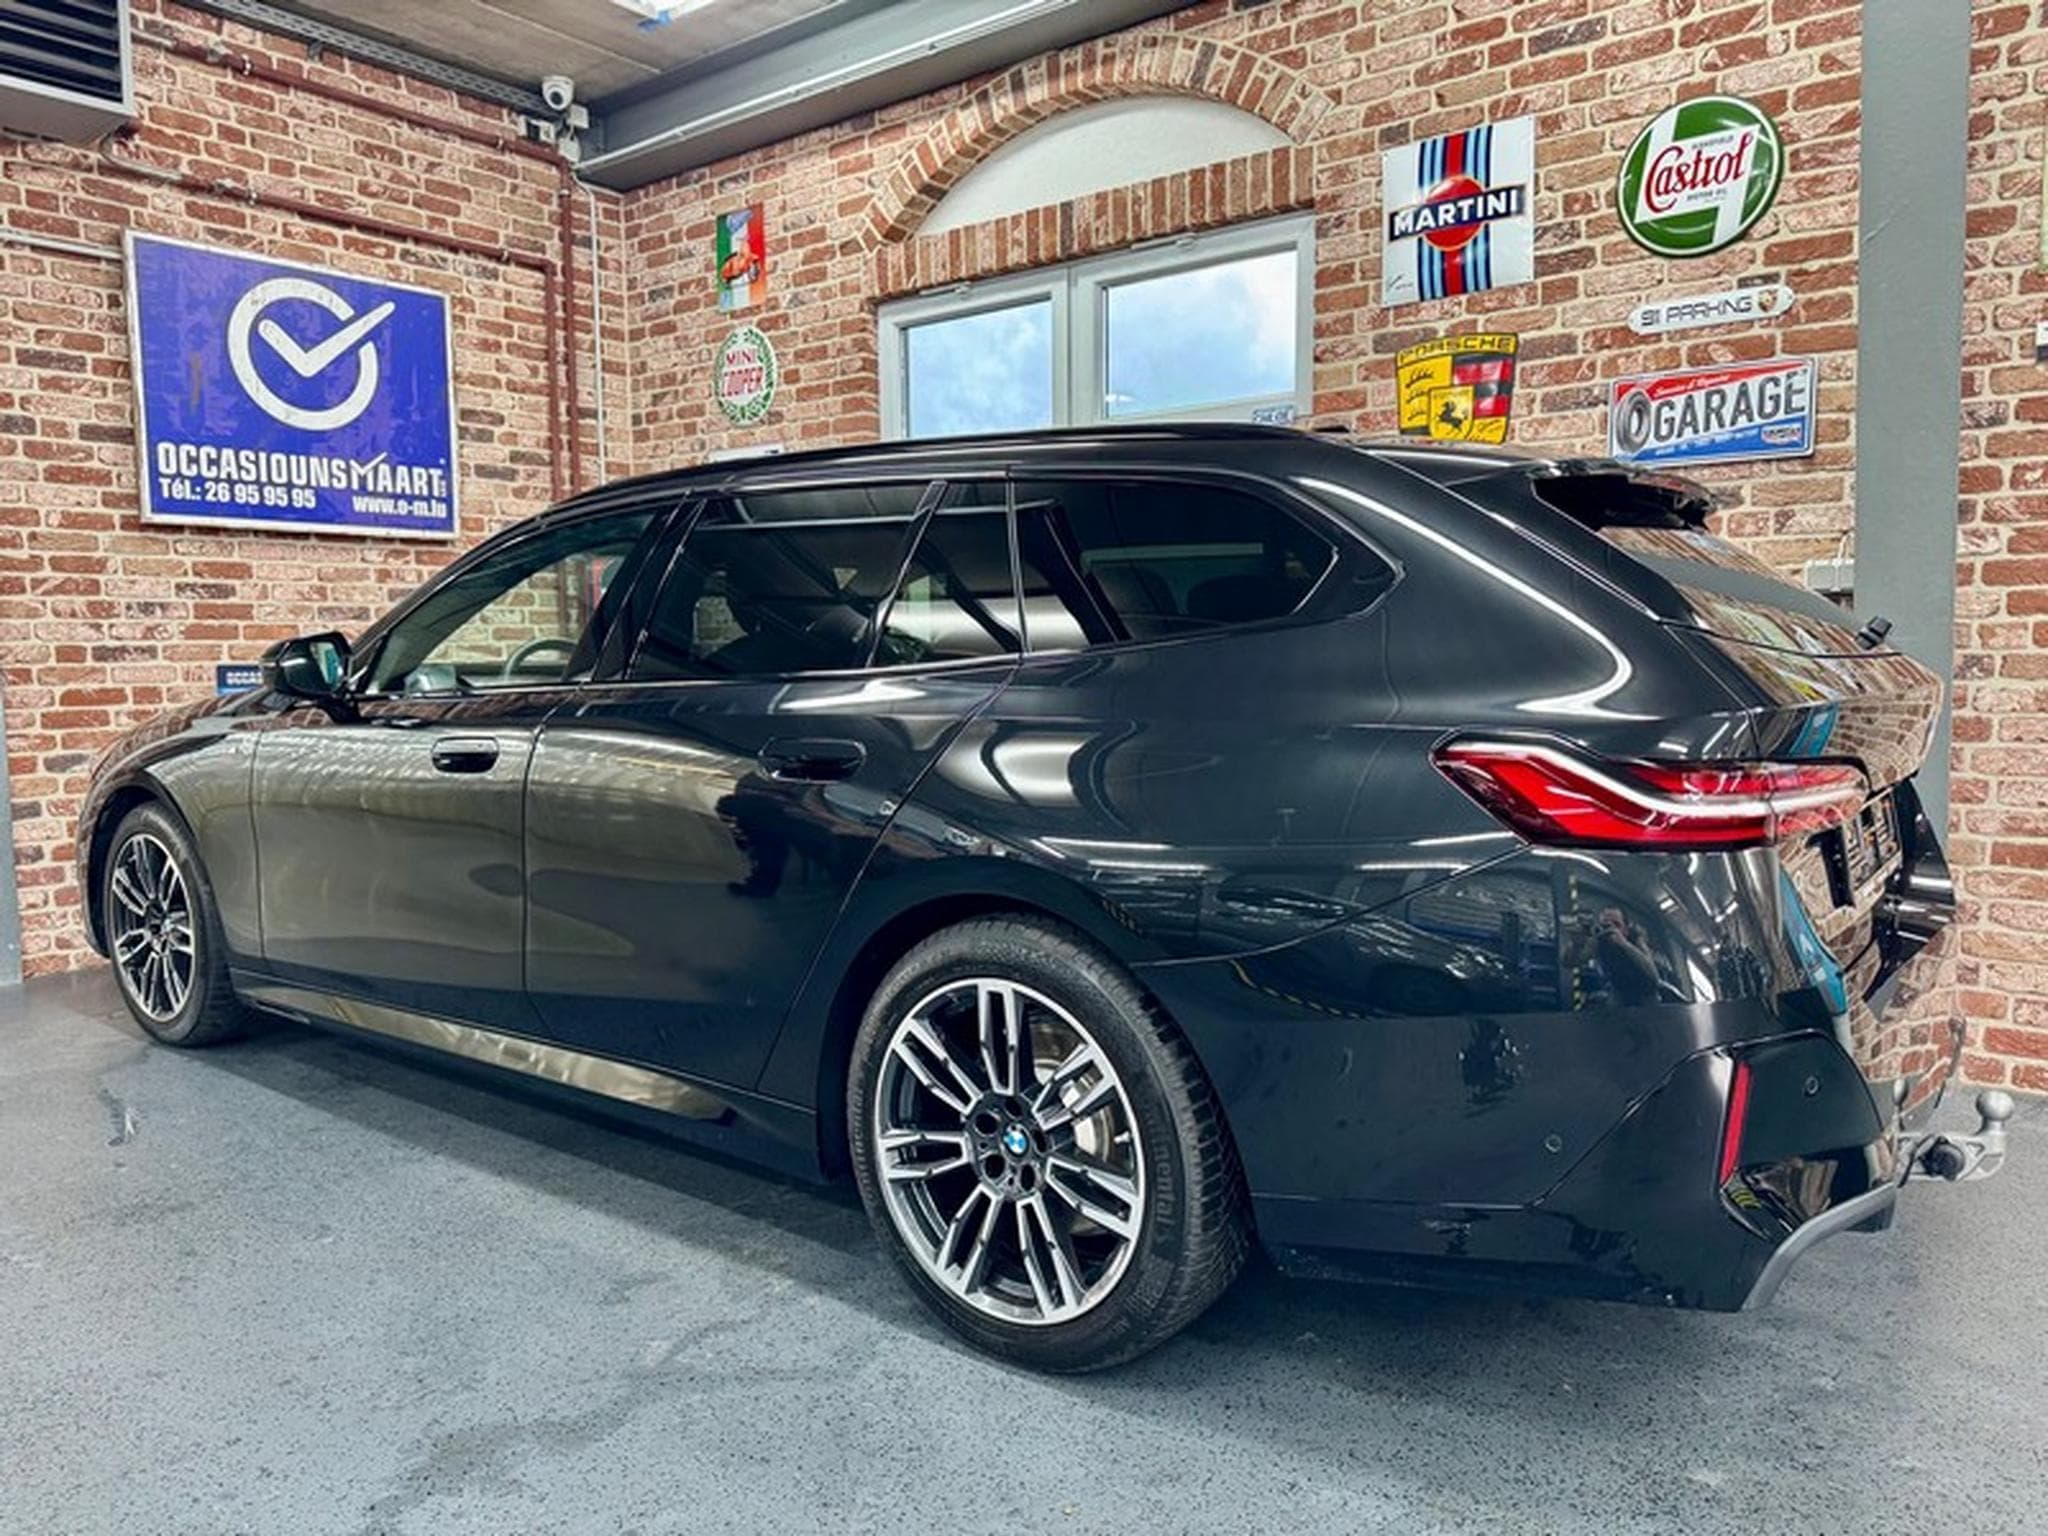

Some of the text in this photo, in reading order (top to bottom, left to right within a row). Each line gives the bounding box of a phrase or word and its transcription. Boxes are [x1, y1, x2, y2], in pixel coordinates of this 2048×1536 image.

[1644, 131, 1754, 214] Castrol
[1393, 188, 1518, 237] MARTINI
[1665, 295, 1752, 324] PARKING
[726, 348, 757, 365] MINI
[1400, 337, 1512, 363] PORSCHE
[722, 366, 764, 397] COOPER
[1653, 369, 1807, 443] GARAGE
[157, 441, 444, 497] OCCASIOUNSMAART
[159, 478, 317, 509] Tél.: 26 95 95 95
[353, 496, 447, 519] www.o-m.lu
[1143, 1094, 1177, 1226] ntinental
